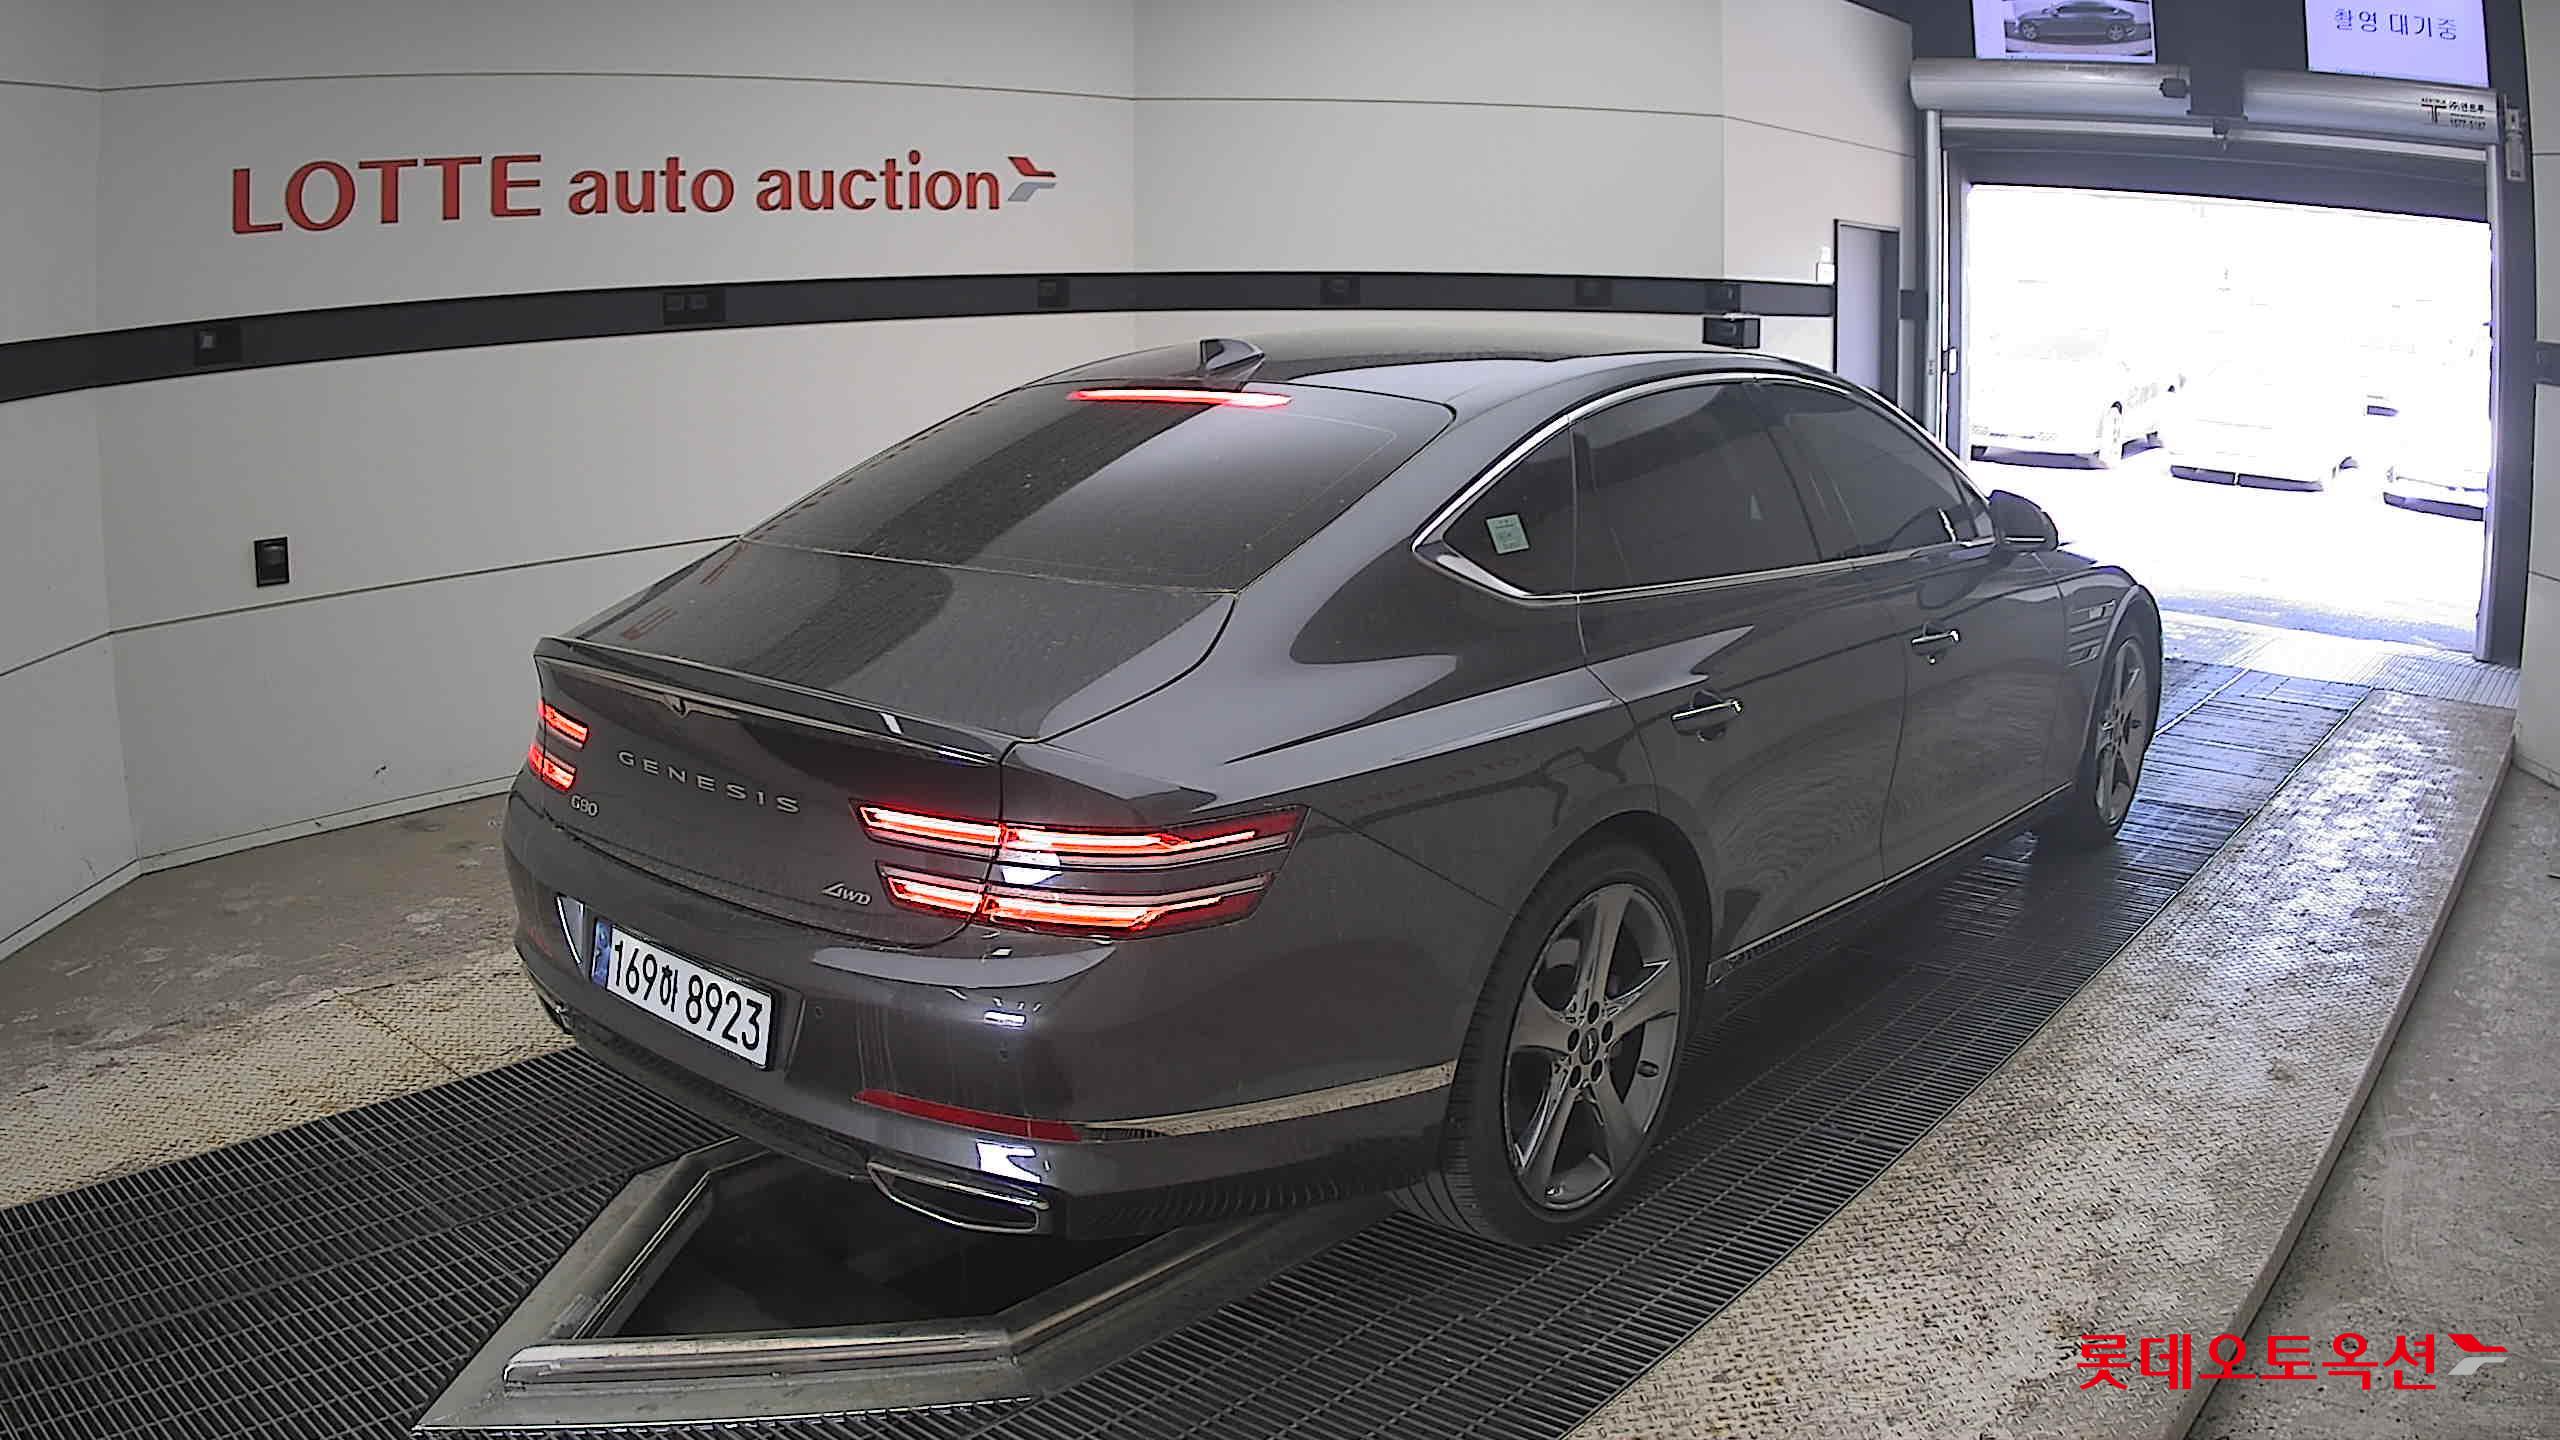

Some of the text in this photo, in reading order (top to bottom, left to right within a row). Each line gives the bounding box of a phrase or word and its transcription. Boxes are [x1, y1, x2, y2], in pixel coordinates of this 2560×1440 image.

[2335, 8, 2457, 41] 촬영 대기중
[233, 150, 1002, 235] LOTTE auto auction
[570, 794, 599, 817] G80
[617, 749, 801, 814] GENESIS
[613, 939, 764, 1051] 169하 8923
